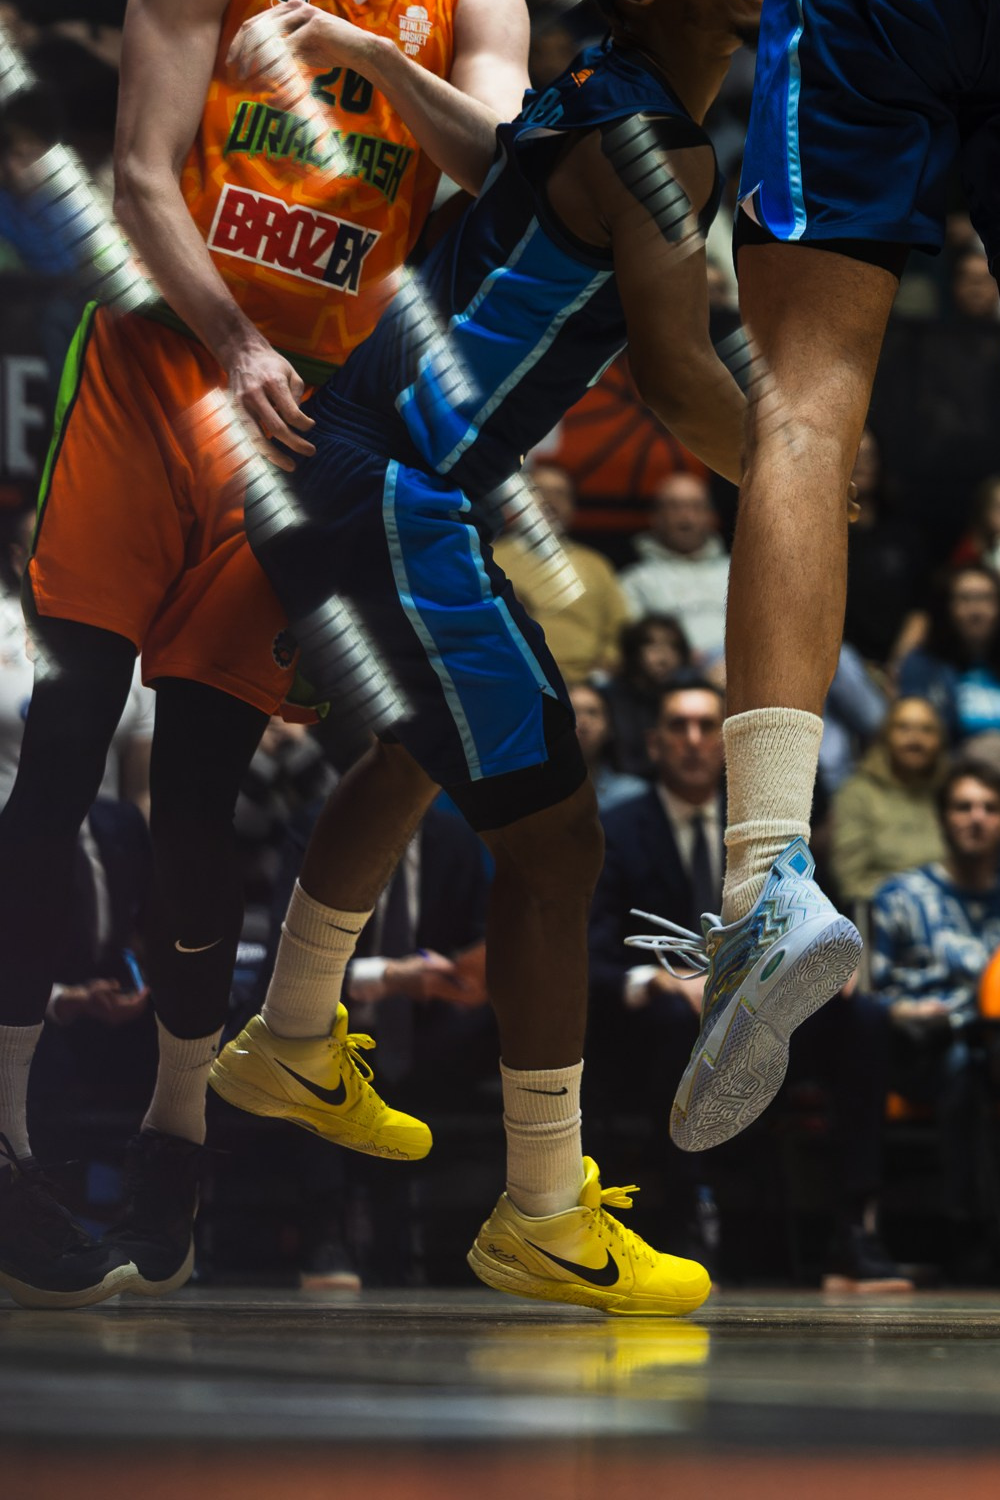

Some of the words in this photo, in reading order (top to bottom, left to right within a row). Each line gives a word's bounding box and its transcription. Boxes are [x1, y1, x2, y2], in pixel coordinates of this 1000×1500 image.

[399, 17, 432, 36] WINLINE
[399, 30, 428, 47] BASKET
[404, 43, 420, 56] CUP
[310, 67, 373, 114] 20
[211, 187, 377, 292] BROZEX
